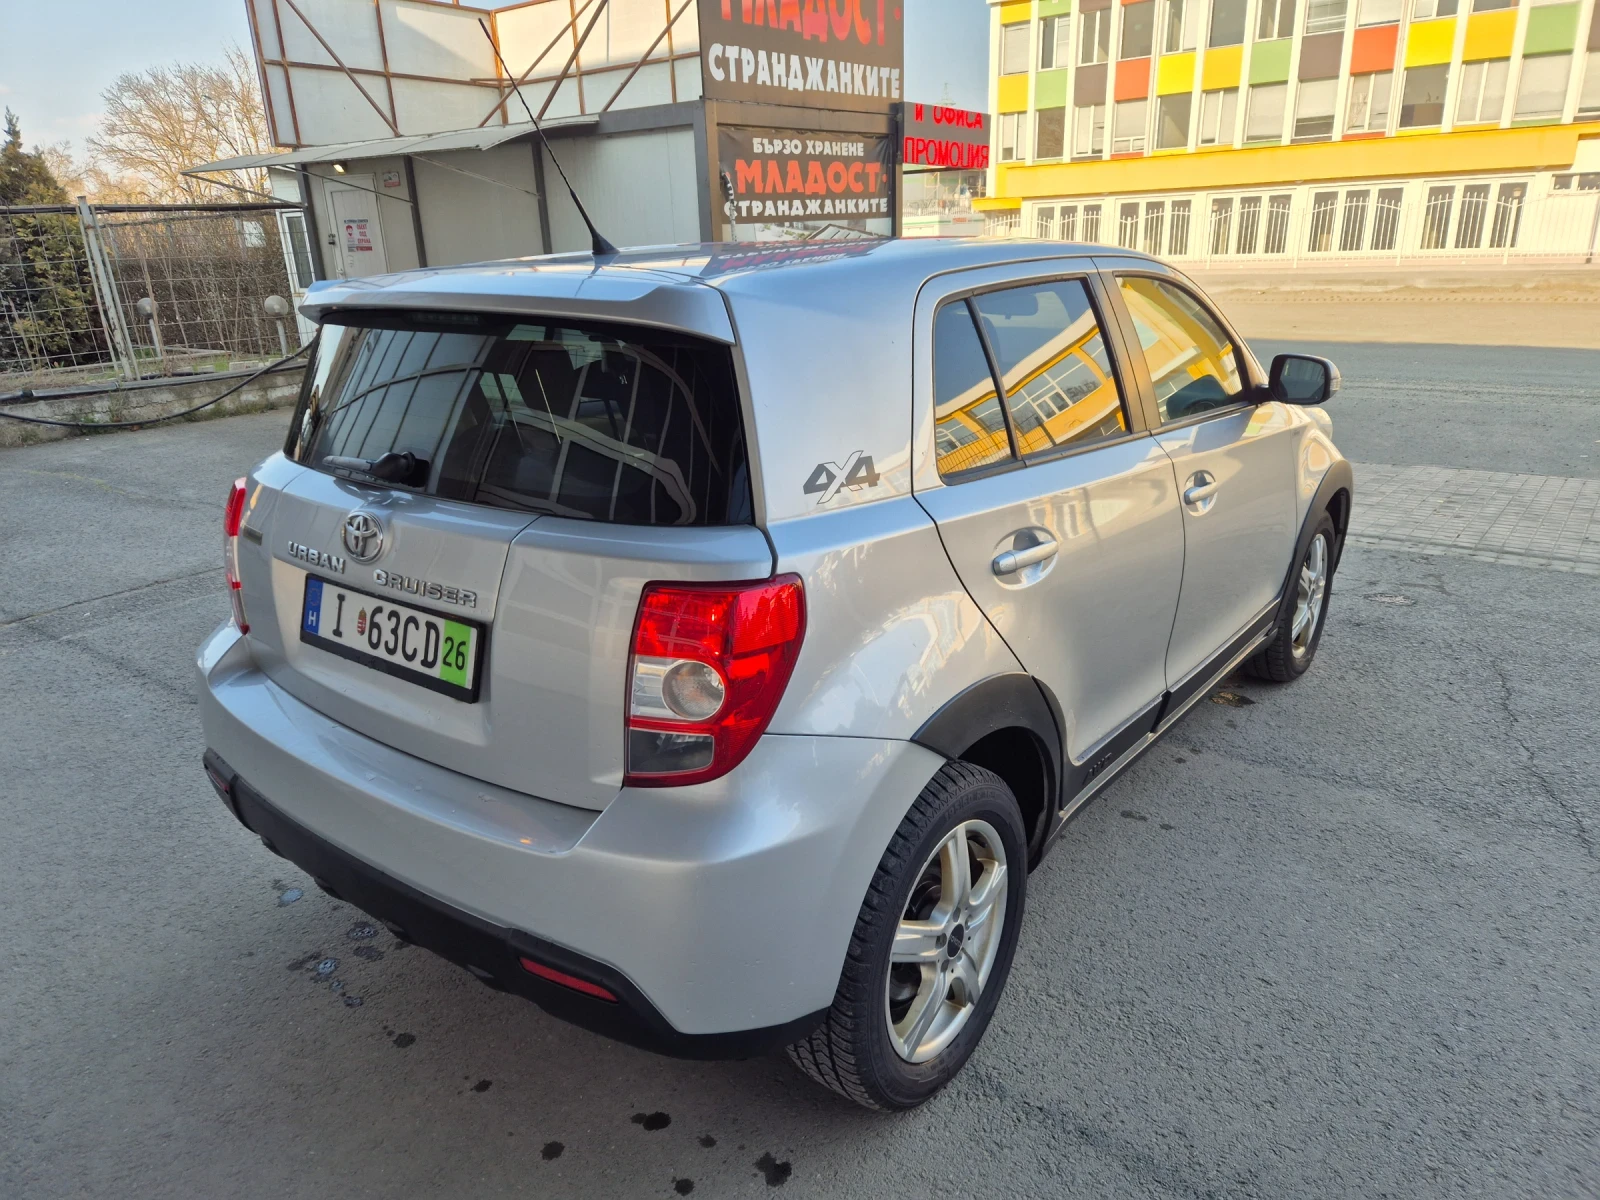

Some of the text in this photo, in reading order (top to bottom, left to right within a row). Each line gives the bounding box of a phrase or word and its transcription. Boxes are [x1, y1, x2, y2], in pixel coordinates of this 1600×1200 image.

[708, 43, 900, 98] СТРАНДЖАНКИТЕ
[752, 138, 864, 157] БЪРЗО ХРАНЕНЕ
[904, 136, 989, 168] ПРОМОЦИЯ
[735, 159, 881, 195] МЛАДОСТ
[724, 198, 888, 217] СТРАНДЖАНКИТЕ
[288, 541, 477, 608] URBAN CRUISER
[308, 610, 317, 627] H
[367, 606, 440, 669] 63CD
[442, 636, 467, 670] 26
